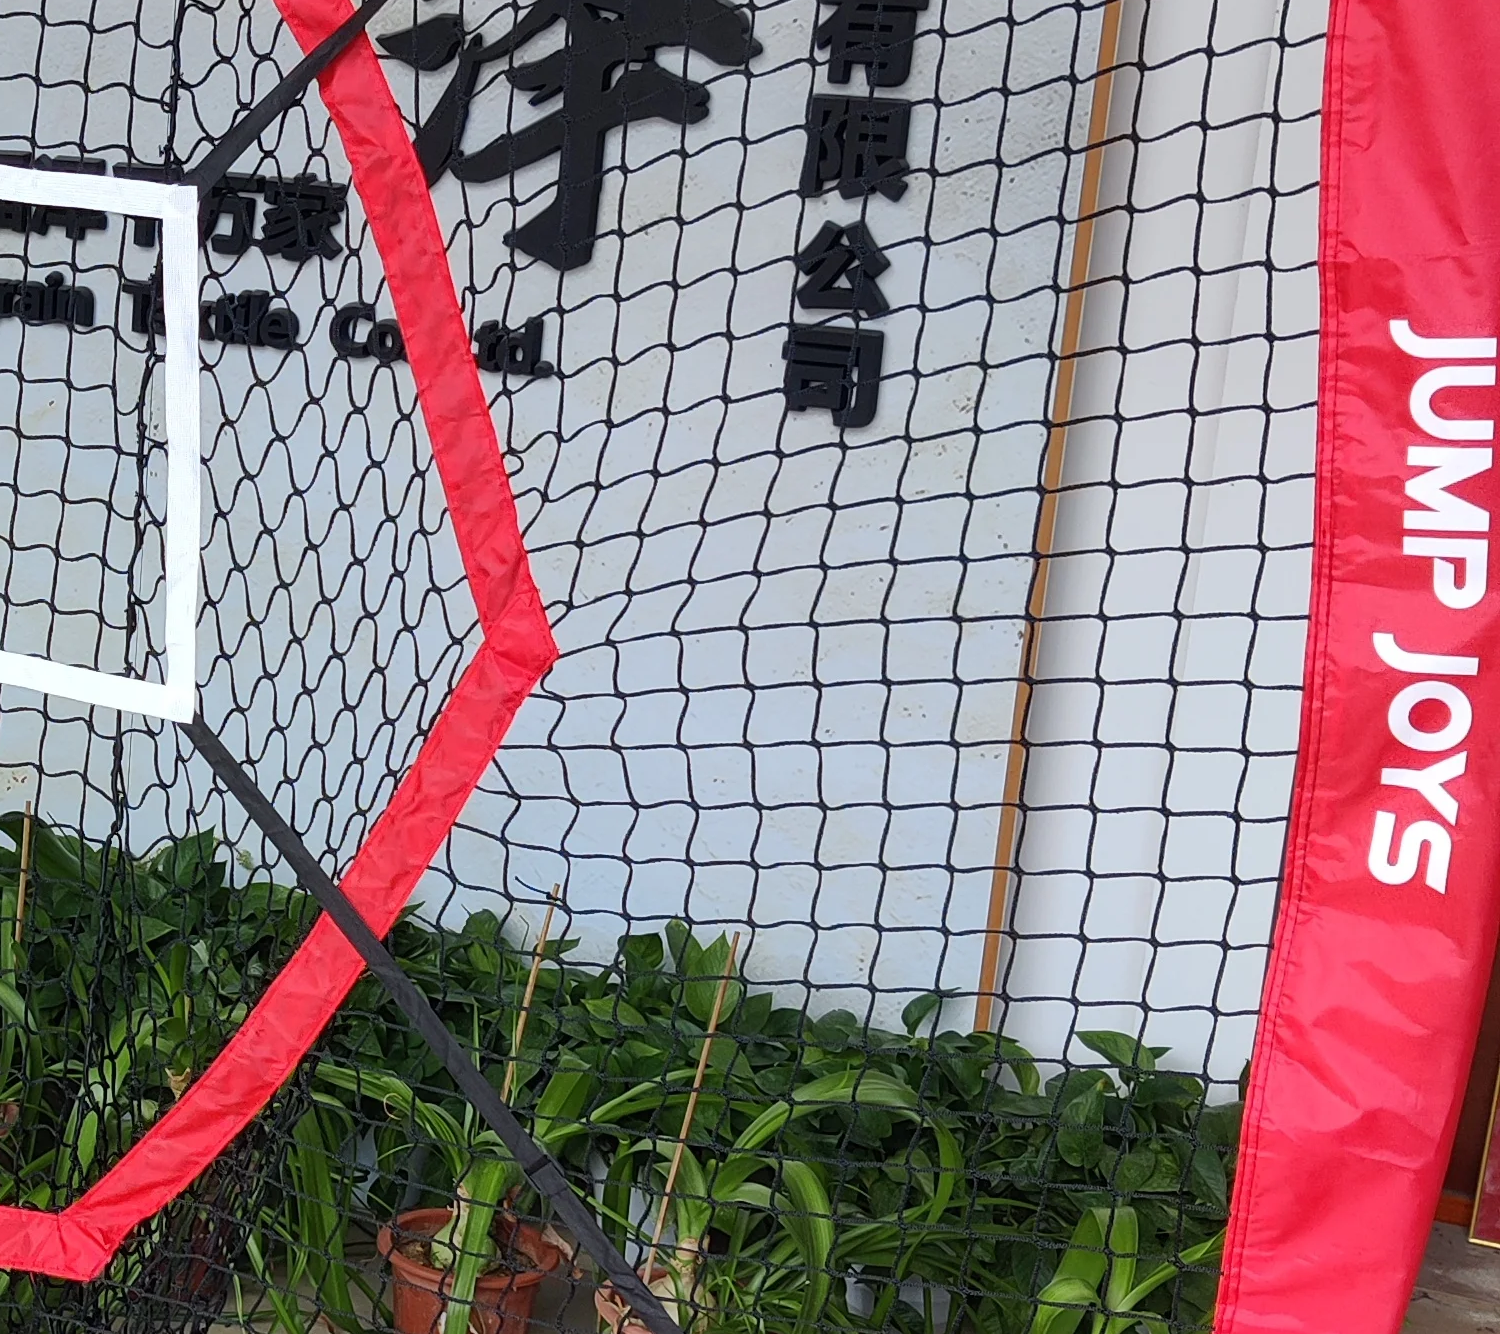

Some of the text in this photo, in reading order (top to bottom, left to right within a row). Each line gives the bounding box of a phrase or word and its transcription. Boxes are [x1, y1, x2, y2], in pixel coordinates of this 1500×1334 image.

[473, 317, 554, 378] td.
[1367, 319, 1498, 895] JUMP JOYS
